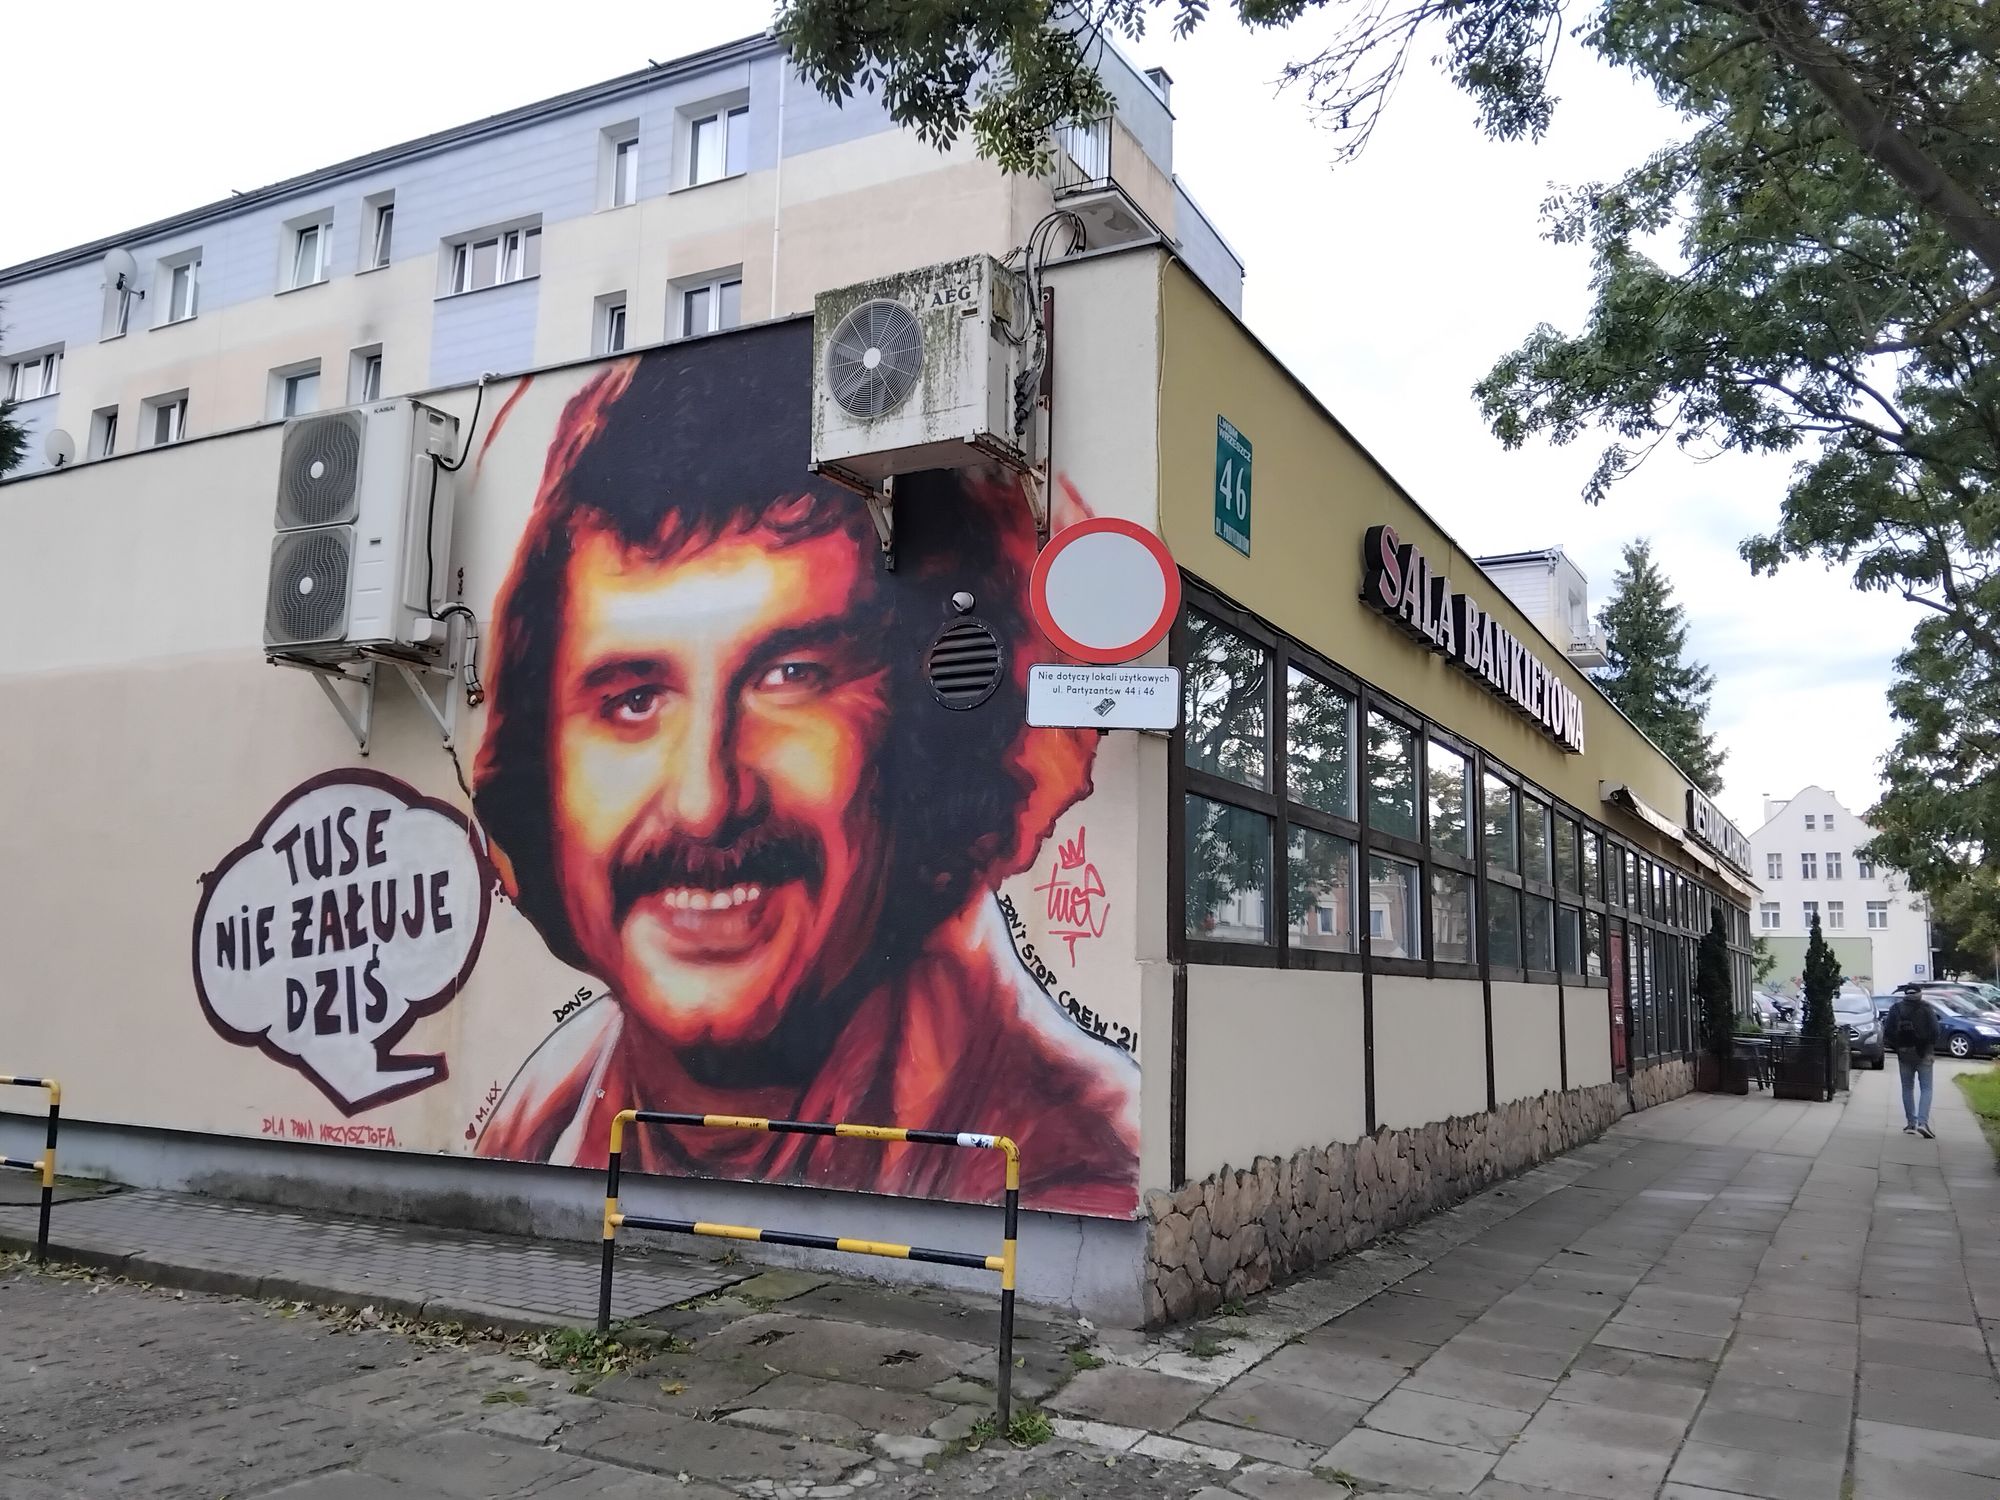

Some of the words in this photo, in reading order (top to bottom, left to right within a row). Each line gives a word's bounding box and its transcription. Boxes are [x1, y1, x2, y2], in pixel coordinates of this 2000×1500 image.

[930, 286, 972, 309] AEG
[1219, 457, 1247, 521] 46
[1378, 524, 1456, 656] SALA
[1464, 593, 1585, 756] BANKIETOWA
[1038, 671, 1054, 681] Nie
[1056, 671, 1090, 684] dotyczy
[1091, 672, 1117, 682] lokali
[1119, 673, 1170, 684] użytkowych
[1066, 685, 1121, 696] Partyzantów
[1124, 687, 1136, 695] 44
[1143, 687, 1155, 696] 46
[272, 806, 391, 885] TUSE
[286, 943, 389, 1036] DZIŚ
[999, 894, 1027, 940] DON'T
[1021, 942, 1058, 987] STOP
[1058, 990, 1109, 1034] CREW
[1112, 1023, 1139, 1053] '21
[262, 1115, 285, 1137] DLA
